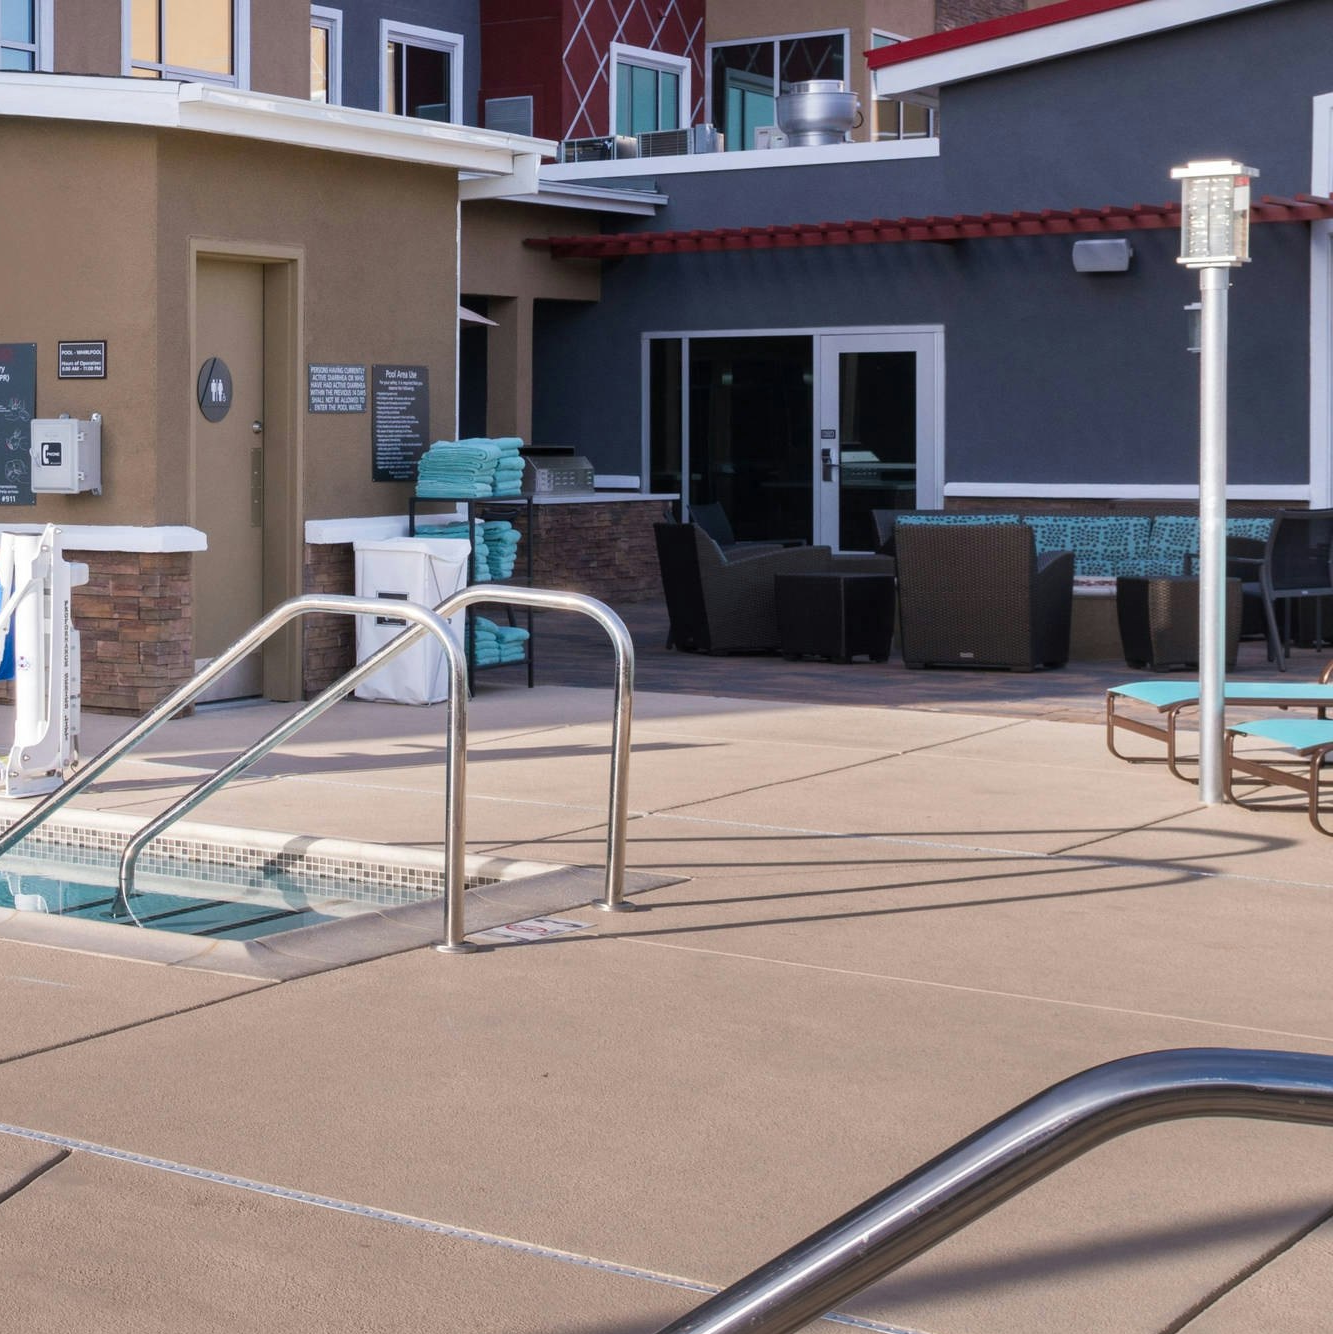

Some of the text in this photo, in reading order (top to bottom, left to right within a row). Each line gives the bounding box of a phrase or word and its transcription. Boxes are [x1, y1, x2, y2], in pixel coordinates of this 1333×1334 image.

[385, 370, 417, 378] Pool Area Use
